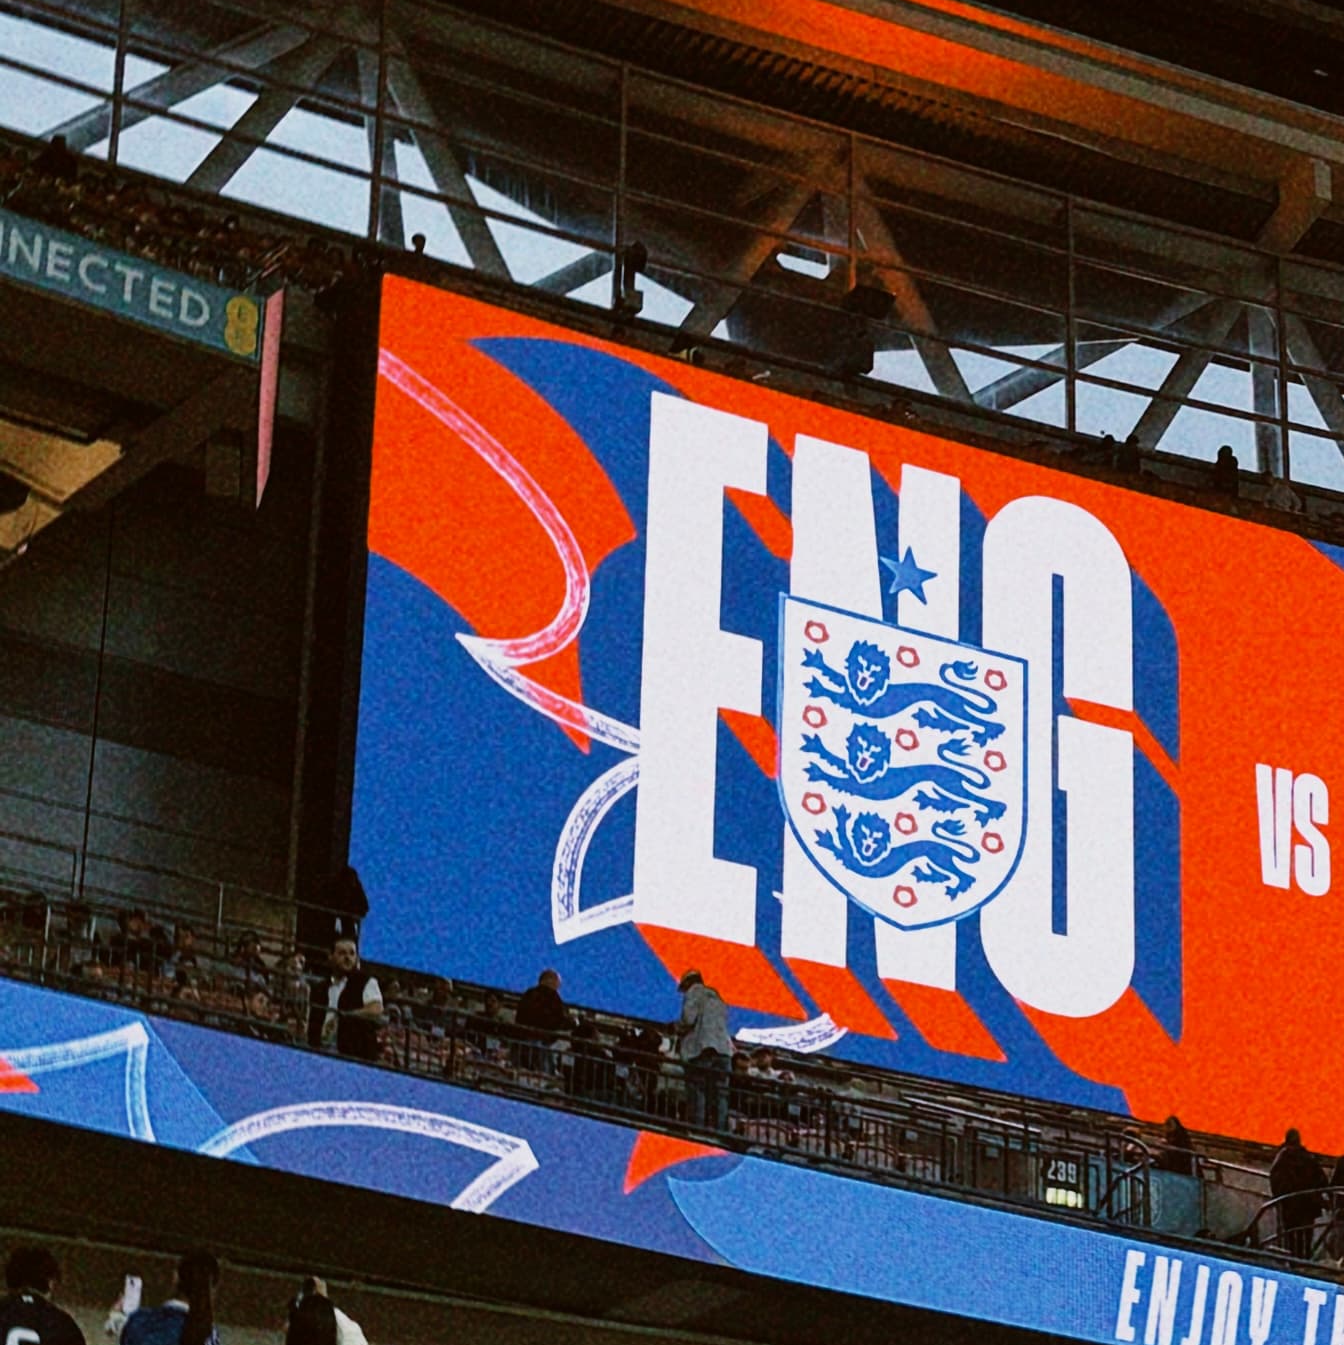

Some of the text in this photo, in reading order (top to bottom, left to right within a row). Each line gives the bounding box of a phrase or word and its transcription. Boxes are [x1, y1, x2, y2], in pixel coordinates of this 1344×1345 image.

[0, 221, 210, 327] NECTED
[633, 391, 1135, 1018] ENG
[1255, 762, 1331, 896] VS
